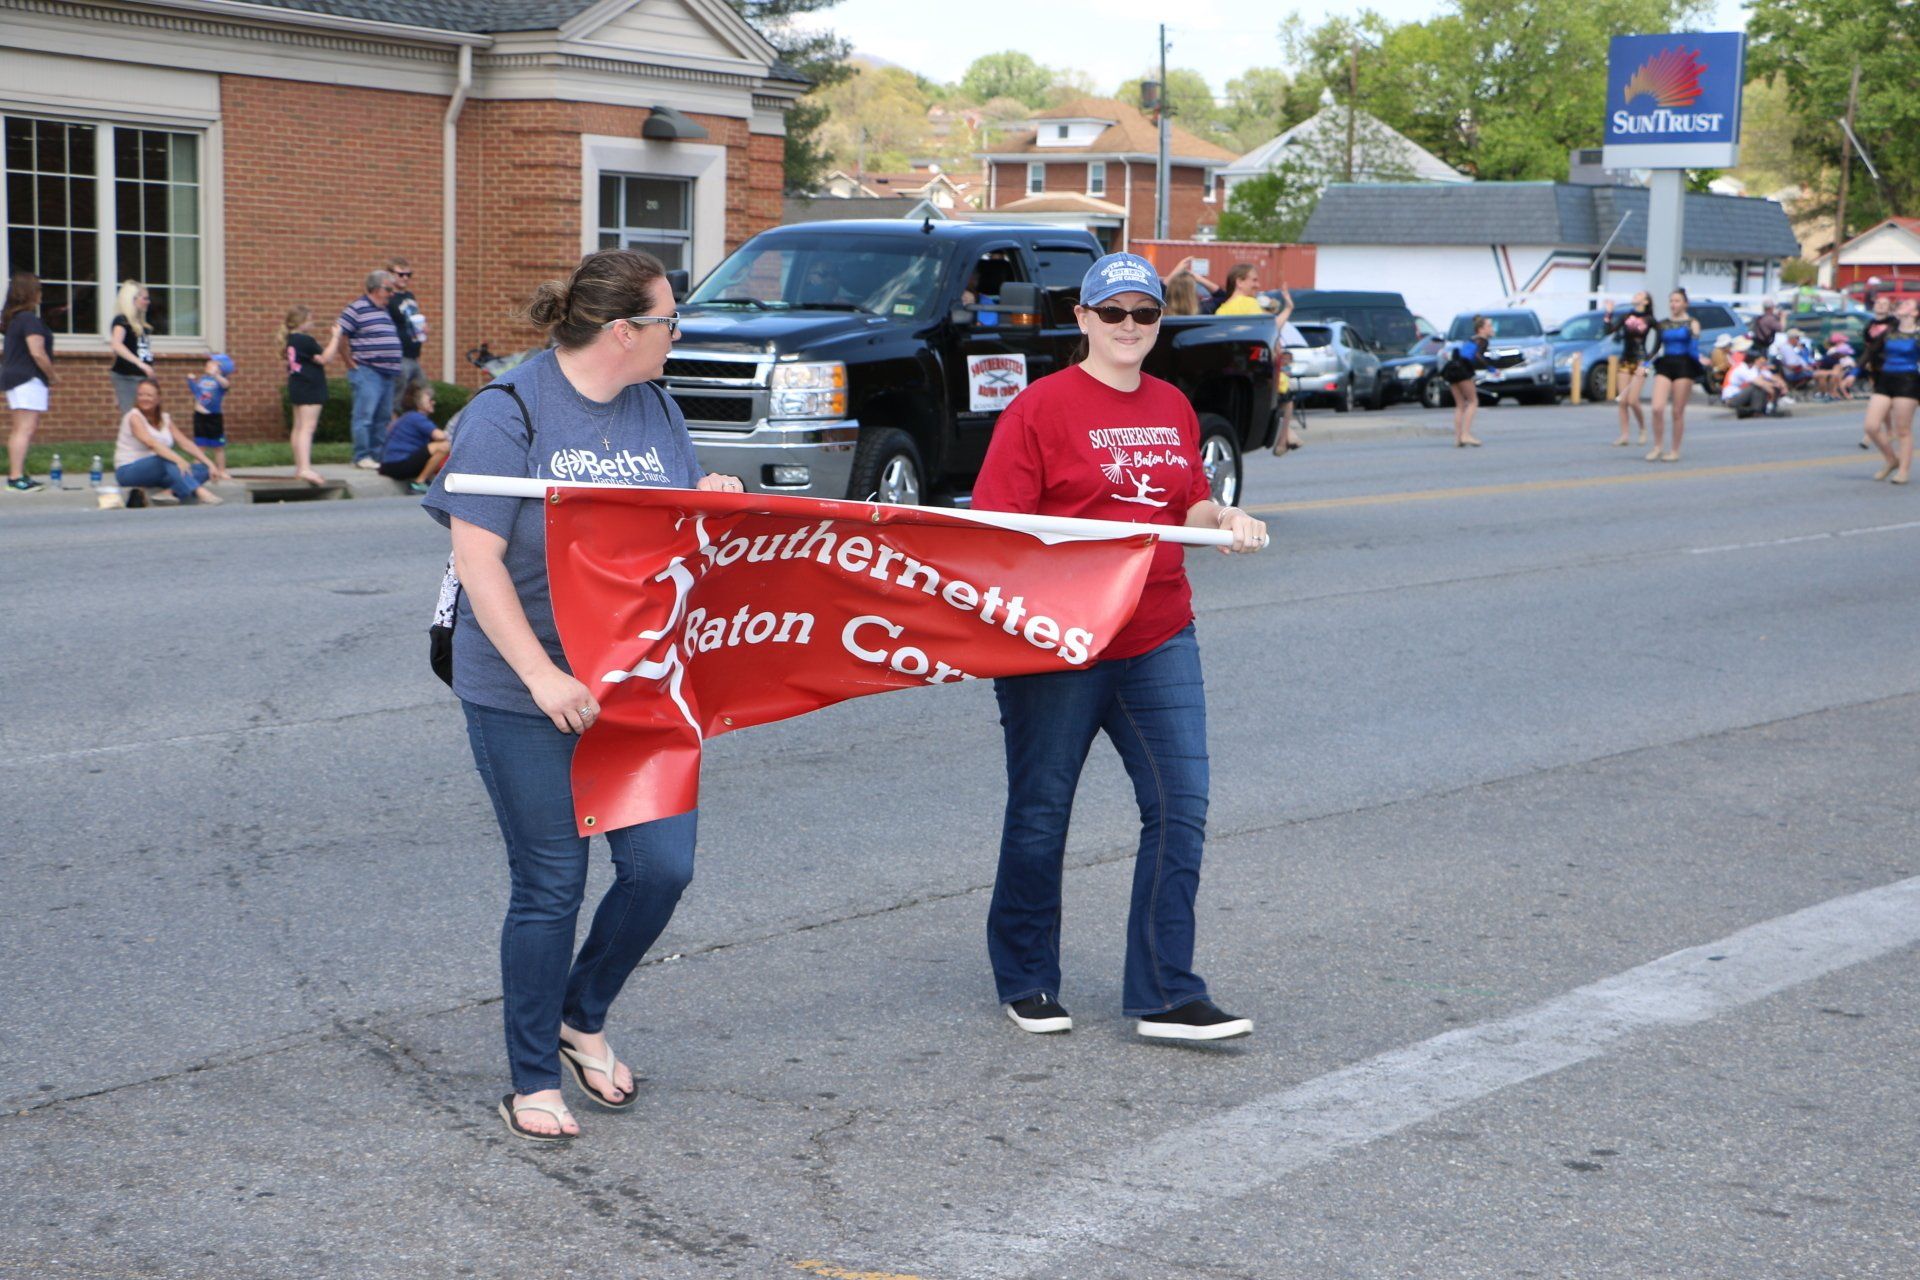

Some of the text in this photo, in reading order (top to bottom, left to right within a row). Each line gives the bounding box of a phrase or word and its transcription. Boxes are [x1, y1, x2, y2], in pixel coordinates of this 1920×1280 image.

[1101, 261, 1152, 276] OUTER BANKS
[1106, 275, 1149, 285] NORTH CAROLINA
[579, 446, 665, 478] Bethel
[1133, 450, 1164, 468] Baton
[632, 471, 671, 484] Church
[684, 604, 978, 684] Baton Cor
